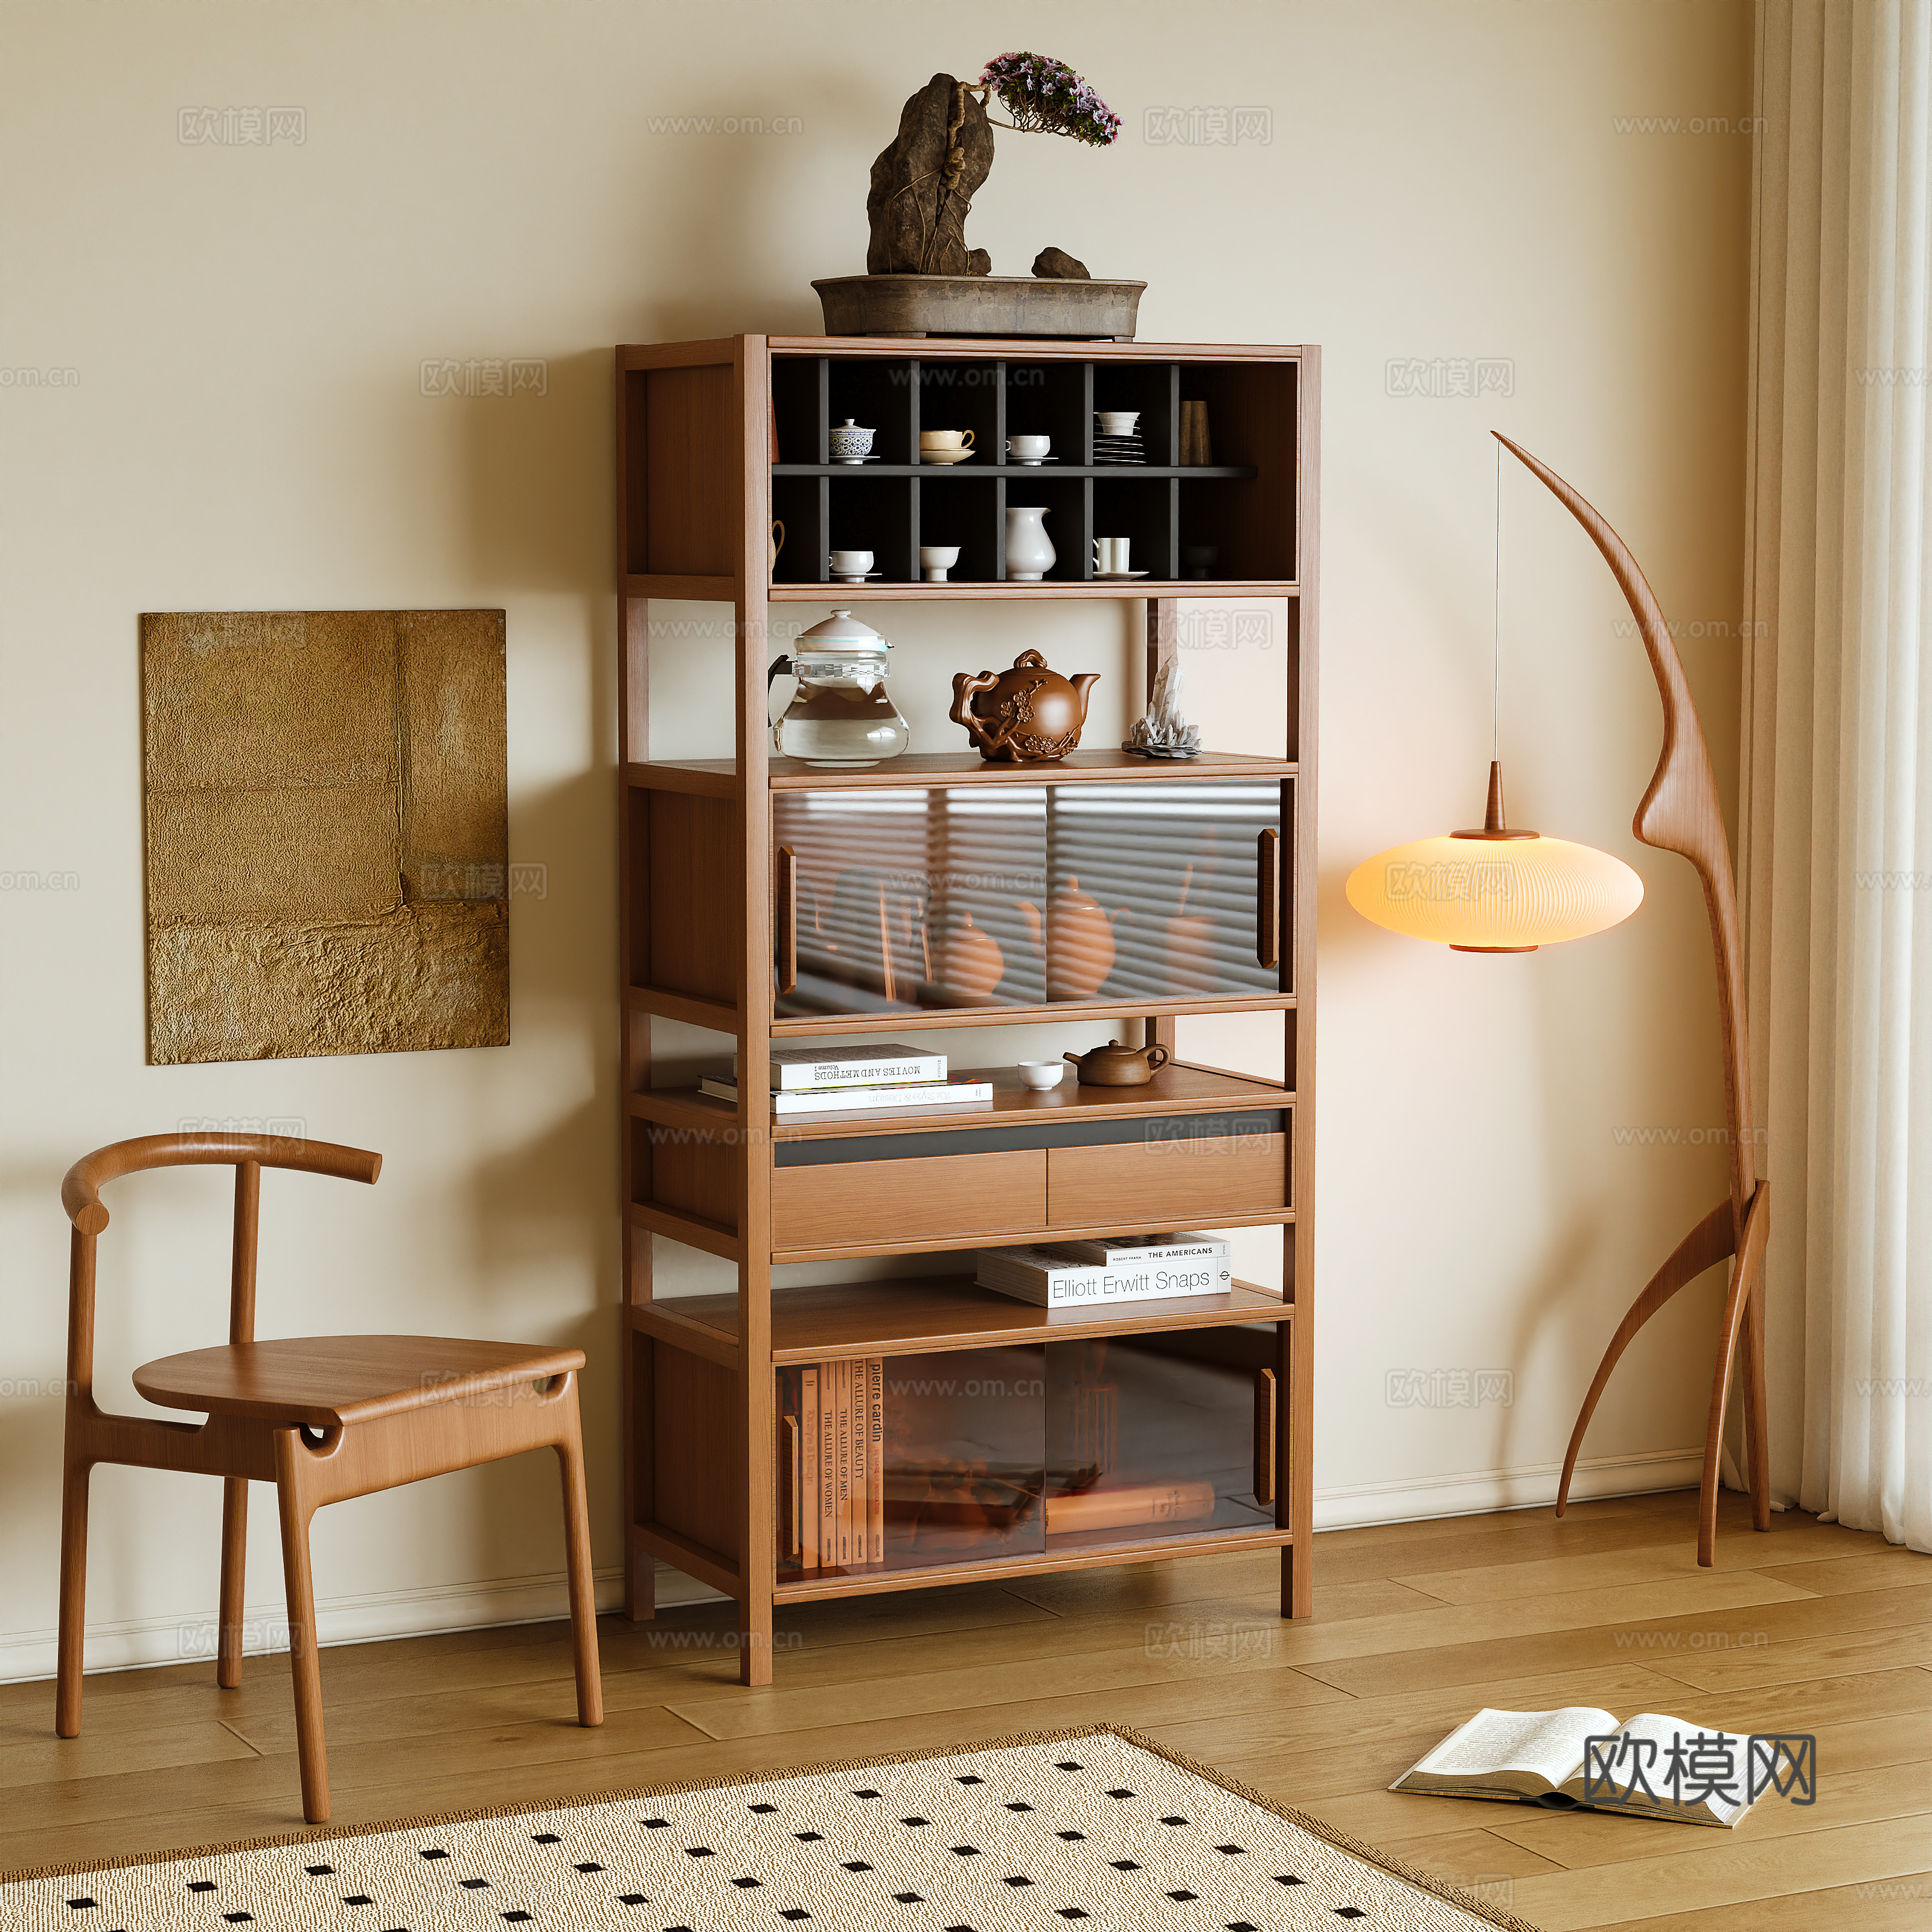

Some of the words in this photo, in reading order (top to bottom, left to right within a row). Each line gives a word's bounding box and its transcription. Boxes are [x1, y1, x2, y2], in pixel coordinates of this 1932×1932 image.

[814, 1069, 860, 1081] METHODS
[861, 1068, 881, 1078] AND
[883, 1066, 920, 1076] MOVIES
[868, 1093, 902, 1104] Design
[913, 1090, 935, 1101] Style
[936, 1091, 952, 1100] 70s
[1166, 1247, 1213, 1257] AMERICANS
[1053, 1279, 1098, 1299] Elliott
[1104, 1275, 1150, 1294] Erwitt
[1156, 1270, 1210, 1294] Snaps
[854, 1359, 864, 1380] THE
[869, 1363, 882, 1399] pierre
[854, 1382, 864, 1422] ALLURE
[824, 1410, 833, 1430] THE
[839, 1409, 848, 1428] THE
[871, 1404, 883, 1442] cardin
[855, 1423, 864, 1437] OF
[824, 1431, 833, 1467] ALLURE
[839, 1430, 848, 1465] ALLURE
[854, 1439, 864, 1480] BEAUTY
[824, 1468, 833, 1480] OF
[839, 1467, 848, 1479] OF
[824, 1482, 833, 1518] WOMEN
[839, 1480, 848, 1501] MEN
